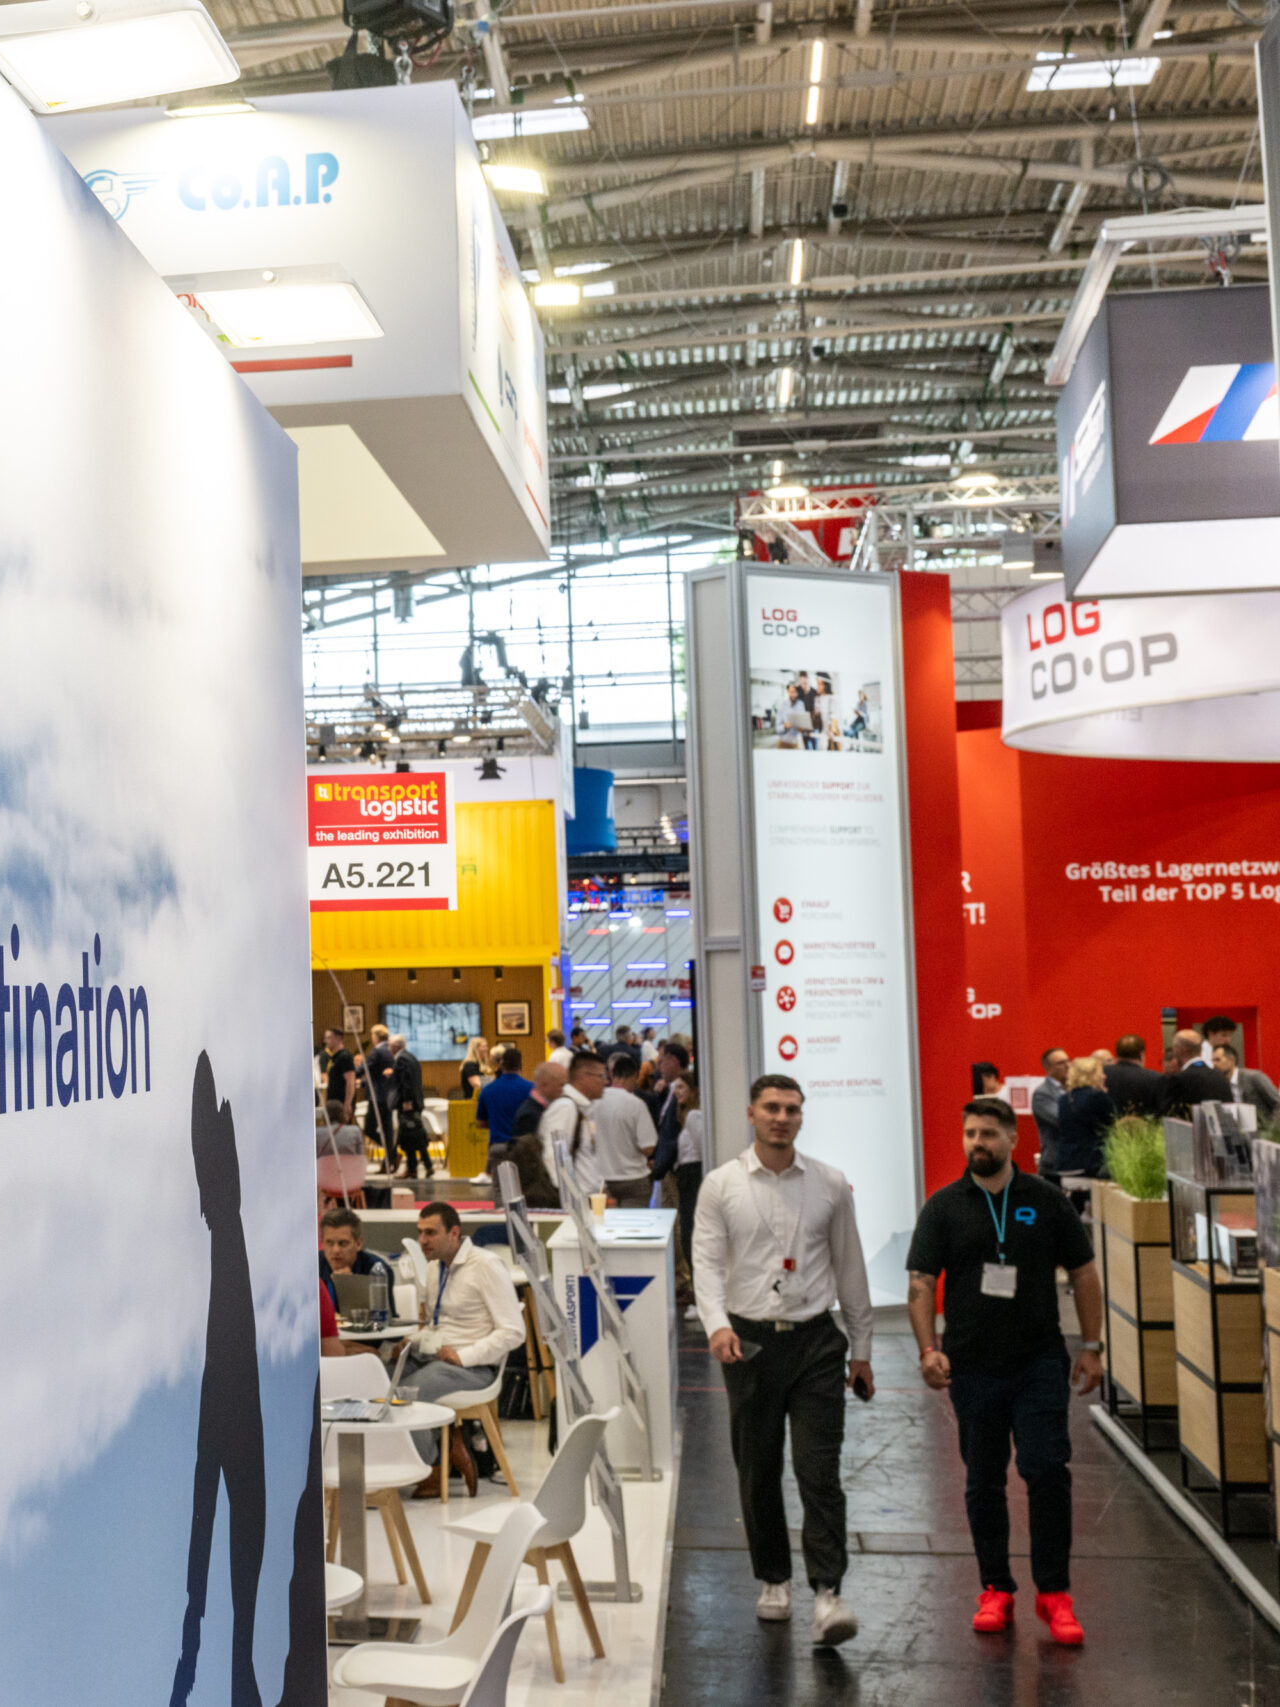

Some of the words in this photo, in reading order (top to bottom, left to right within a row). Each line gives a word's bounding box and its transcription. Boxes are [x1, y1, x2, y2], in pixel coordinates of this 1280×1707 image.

[761, 608, 798, 622] LOG
[1026, 600, 1101, 652] LOG
[334, 780, 438, 802] transport
[360, 797, 439, 822] logistic
[315, 831, 335, 842] the
[337, 829, 380, 843] leading
[382, 828, 440, 841] exhibition
[321, 861, 431, 889] A5.221
[1065, 861, 1151, 880] Größtes
[1098, 884, 1137, 902] Teil
[1142, 884, 1179, 902] der
[1182, 883, 1226, 901] TOP
[1231, 882, 1245, 900] 5
